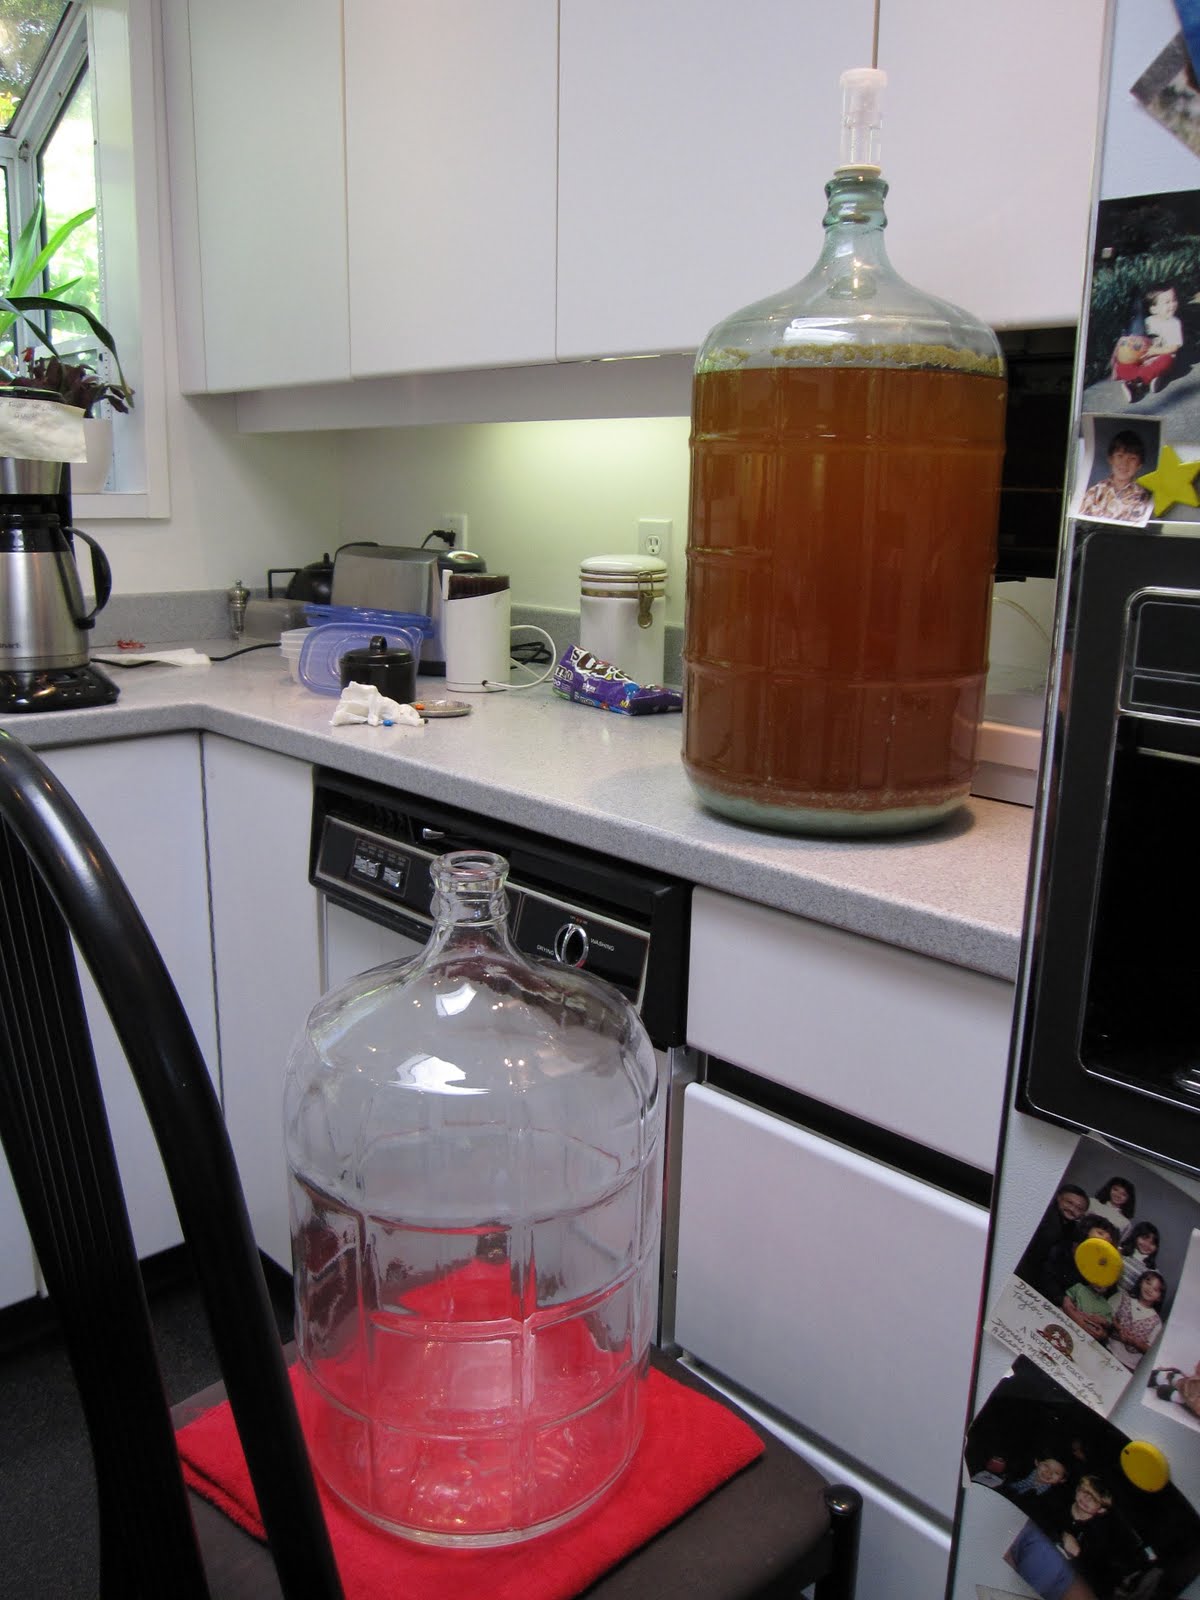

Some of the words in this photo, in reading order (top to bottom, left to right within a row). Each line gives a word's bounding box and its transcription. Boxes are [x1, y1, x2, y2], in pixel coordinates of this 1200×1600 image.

[537, 944, 555, 956] DRYING
[590, 938, 615, 952] WASHING
[1030, 1330, 1053, 1352] World
[1061, 1359, 1084, 1380] Peace
